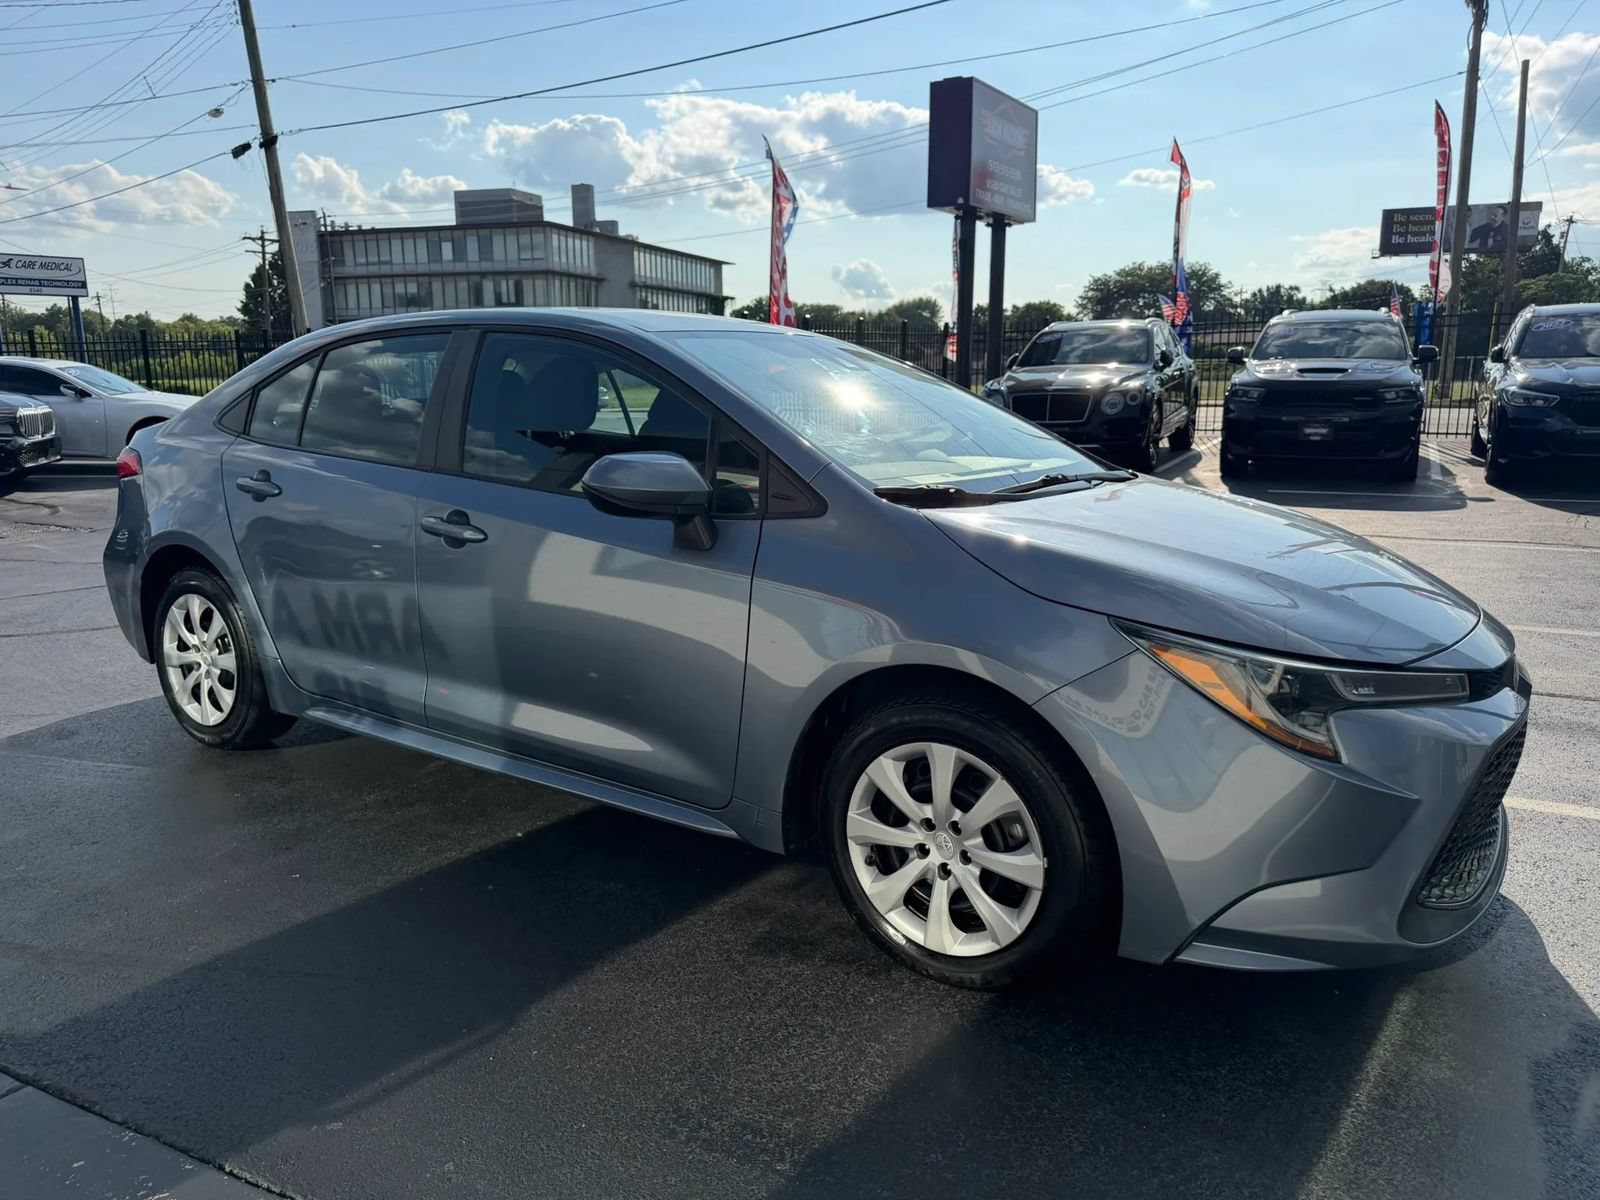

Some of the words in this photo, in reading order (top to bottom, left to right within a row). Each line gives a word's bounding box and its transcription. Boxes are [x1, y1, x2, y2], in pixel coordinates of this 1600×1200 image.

[1393, 213, 1407, 221] Be
[1392, 223, 1406, 232] Be
[1391, 234, 1405, 243] Be
[1407, 233, 1436, 243] heale
[15, 259, 38, 270] CARE
[38, 261, 73, 272] MEDICAL
